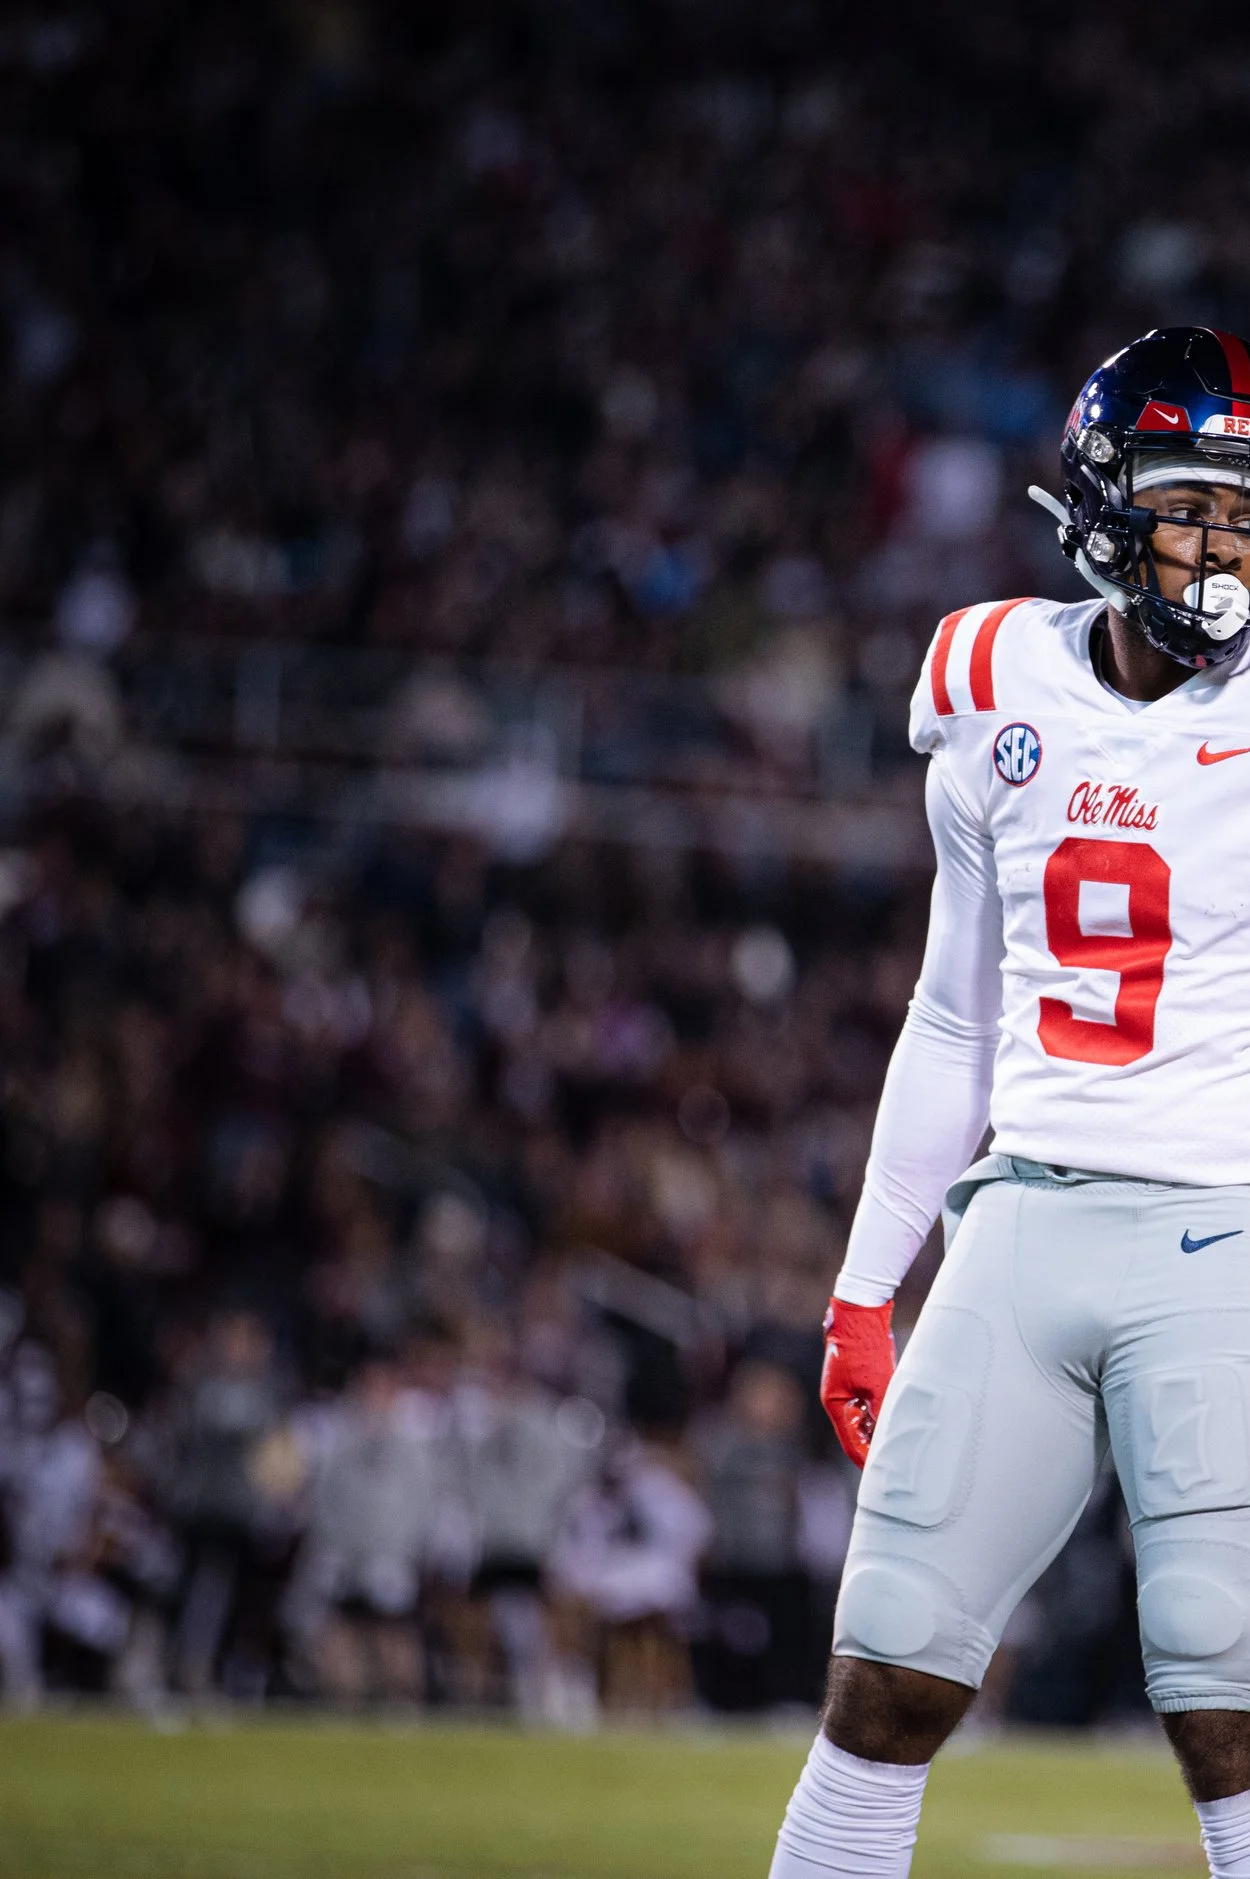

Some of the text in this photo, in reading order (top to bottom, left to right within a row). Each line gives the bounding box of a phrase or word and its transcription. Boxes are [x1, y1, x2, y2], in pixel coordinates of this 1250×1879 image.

[1211, 582, 1239, 591] SHOCK
[995, 726, 1040, 782] SEC
[1067, 781, 1159, 831] Ole Miss
[1037, 837, 1173, 1067] 9
